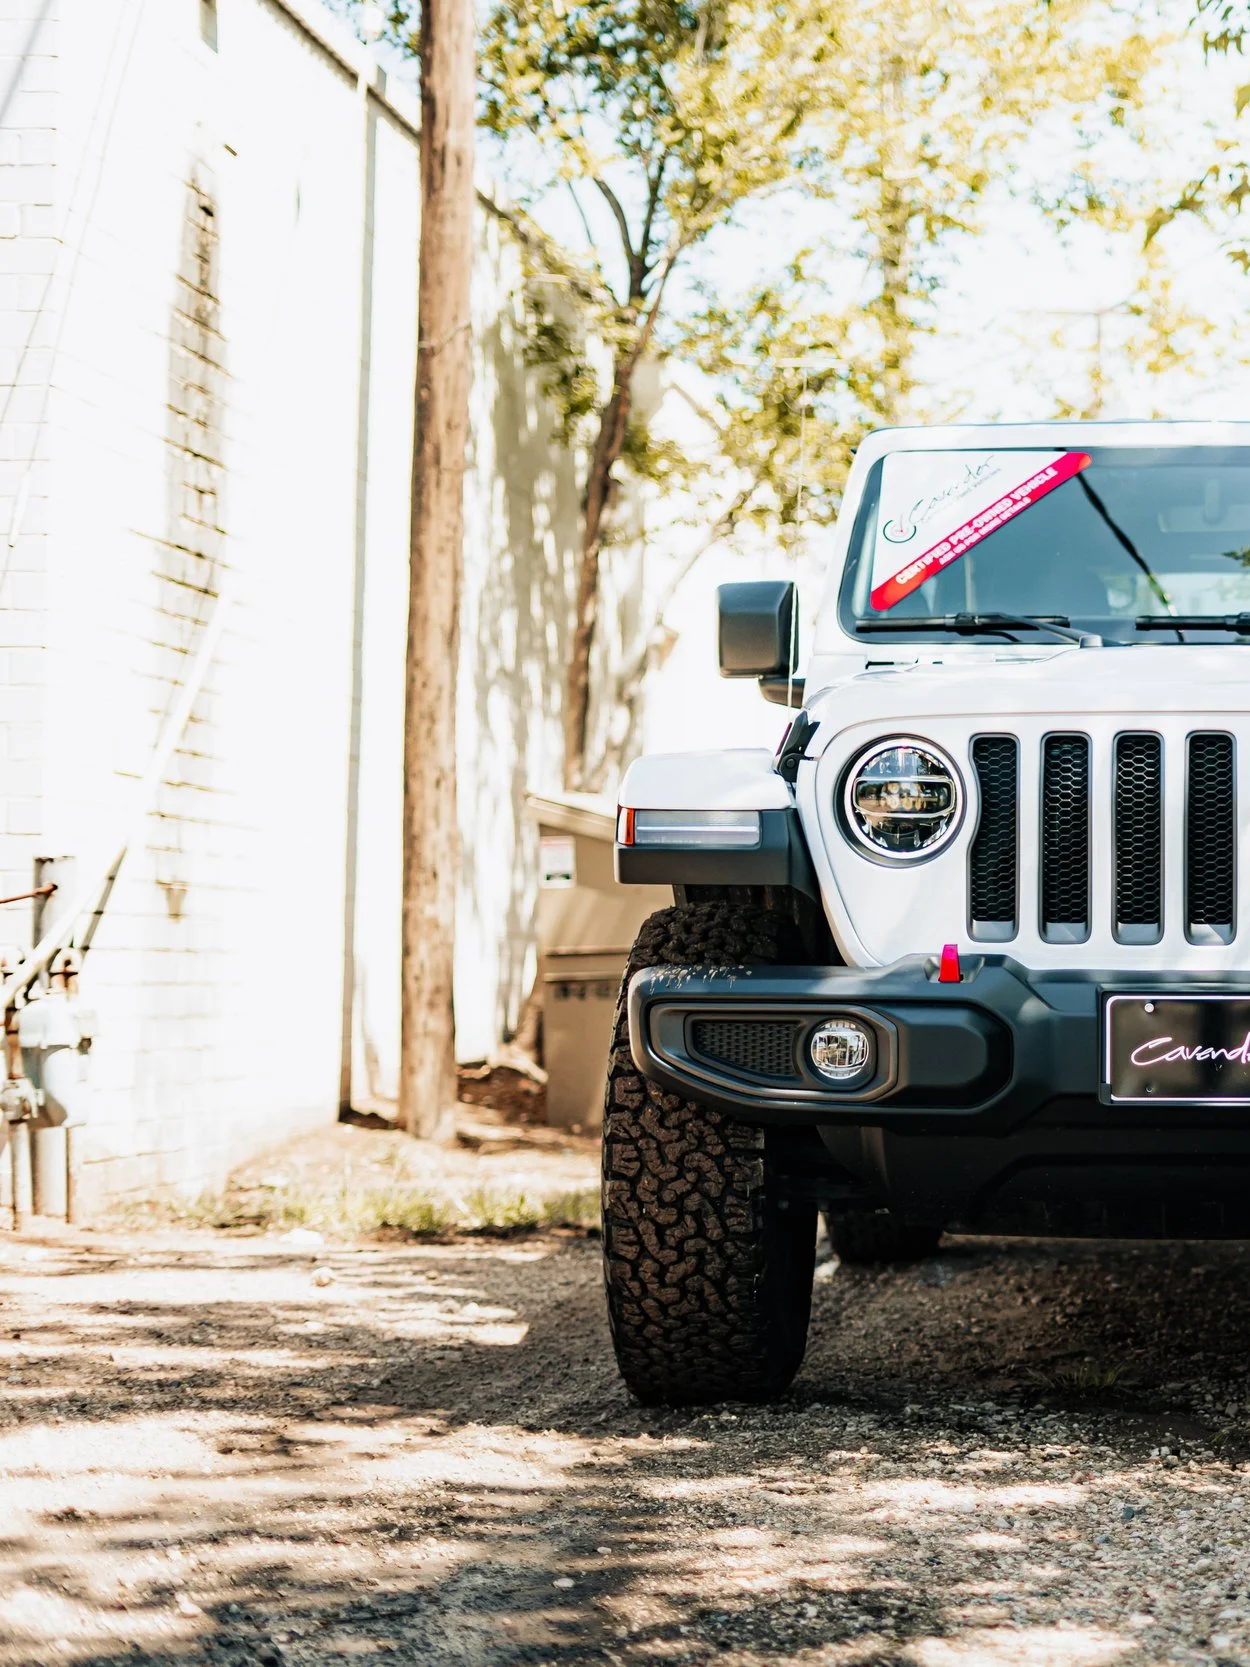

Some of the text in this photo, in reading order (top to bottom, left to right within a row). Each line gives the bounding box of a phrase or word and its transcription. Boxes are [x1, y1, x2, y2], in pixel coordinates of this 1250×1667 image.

[895, 541, 951, 585] CERTIFIED
[948, 497, 1013, 545] PRE-OWNED
[1009, 466, 1059, 501] VEHICLE
[938, 550, 956, 565] ASK
[963, 532, 982, 546] FOR
[978, 517, 1002, 536] MORE
[999, 496, 1032, 521] DETAILS
